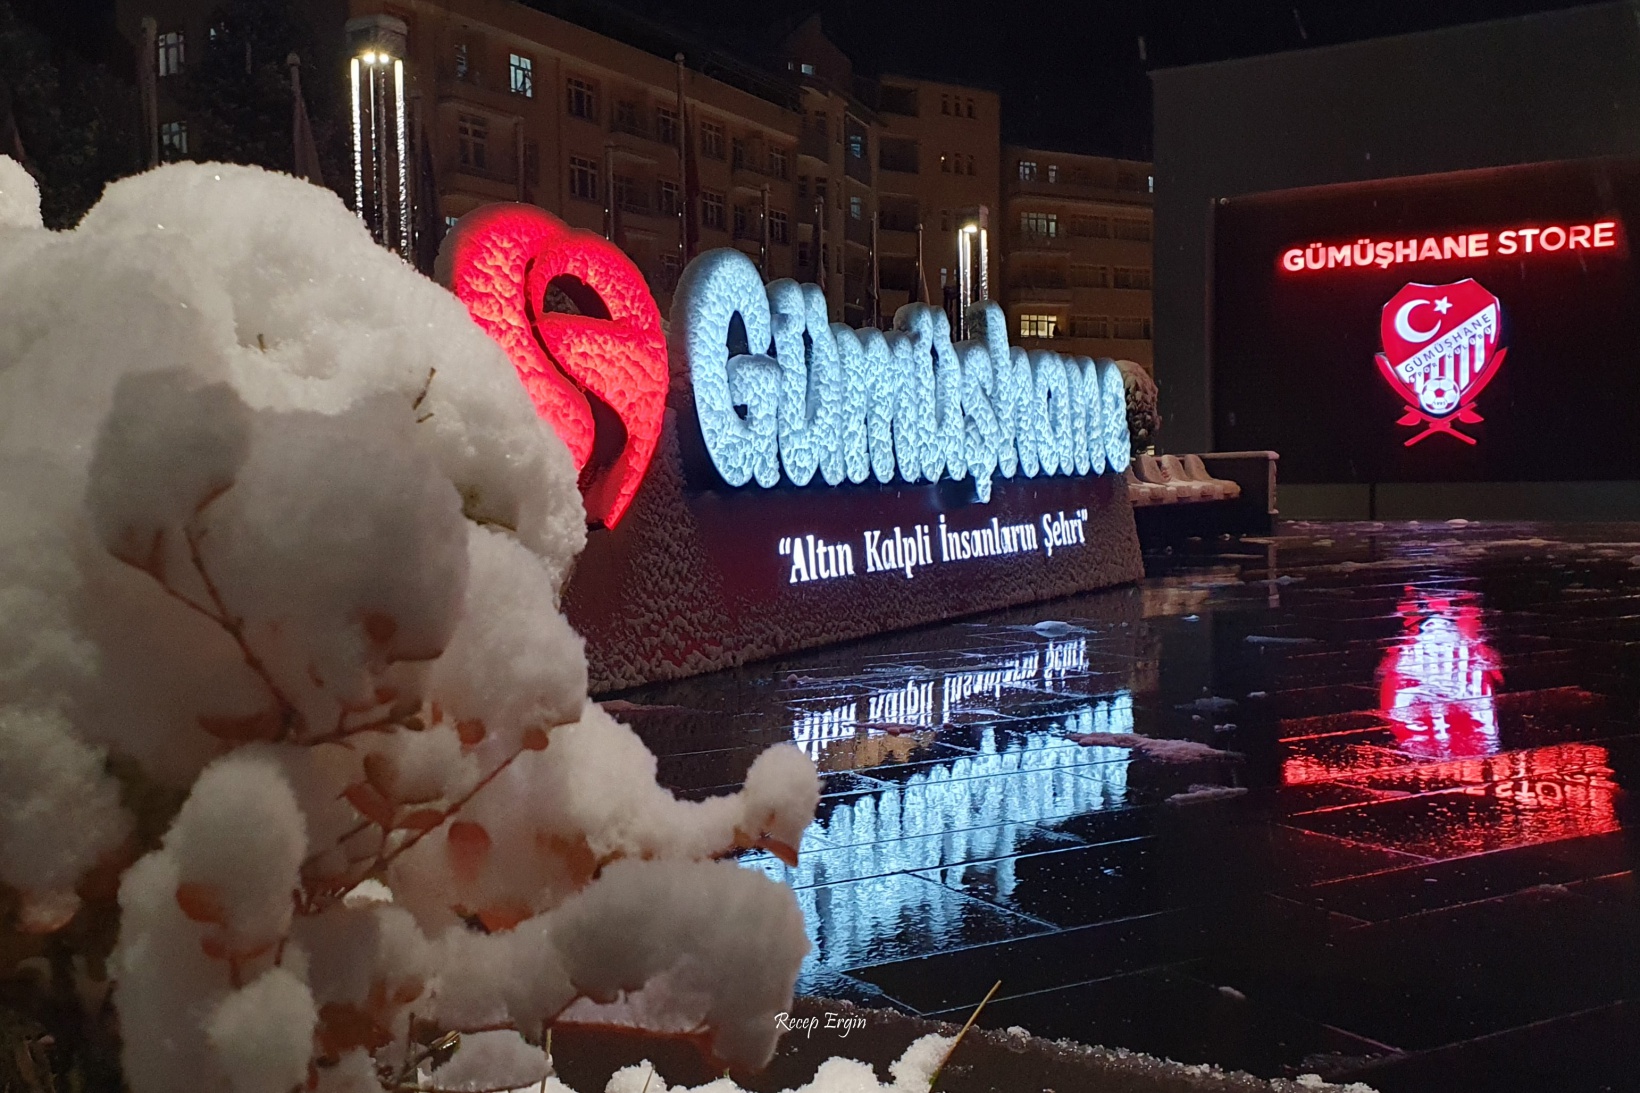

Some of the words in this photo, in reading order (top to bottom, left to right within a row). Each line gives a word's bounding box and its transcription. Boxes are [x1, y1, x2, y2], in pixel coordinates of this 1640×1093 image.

[1283, 232, 1489, 271] GÜMÜŞHANE
[1497, 221, 1616, 255] STORE
[1404, 313, 1491, 373] GÜMÜŞHANE
[863, 523, 933, 579] Kalpli
[939, 514, 1039, 563] İnsanların
